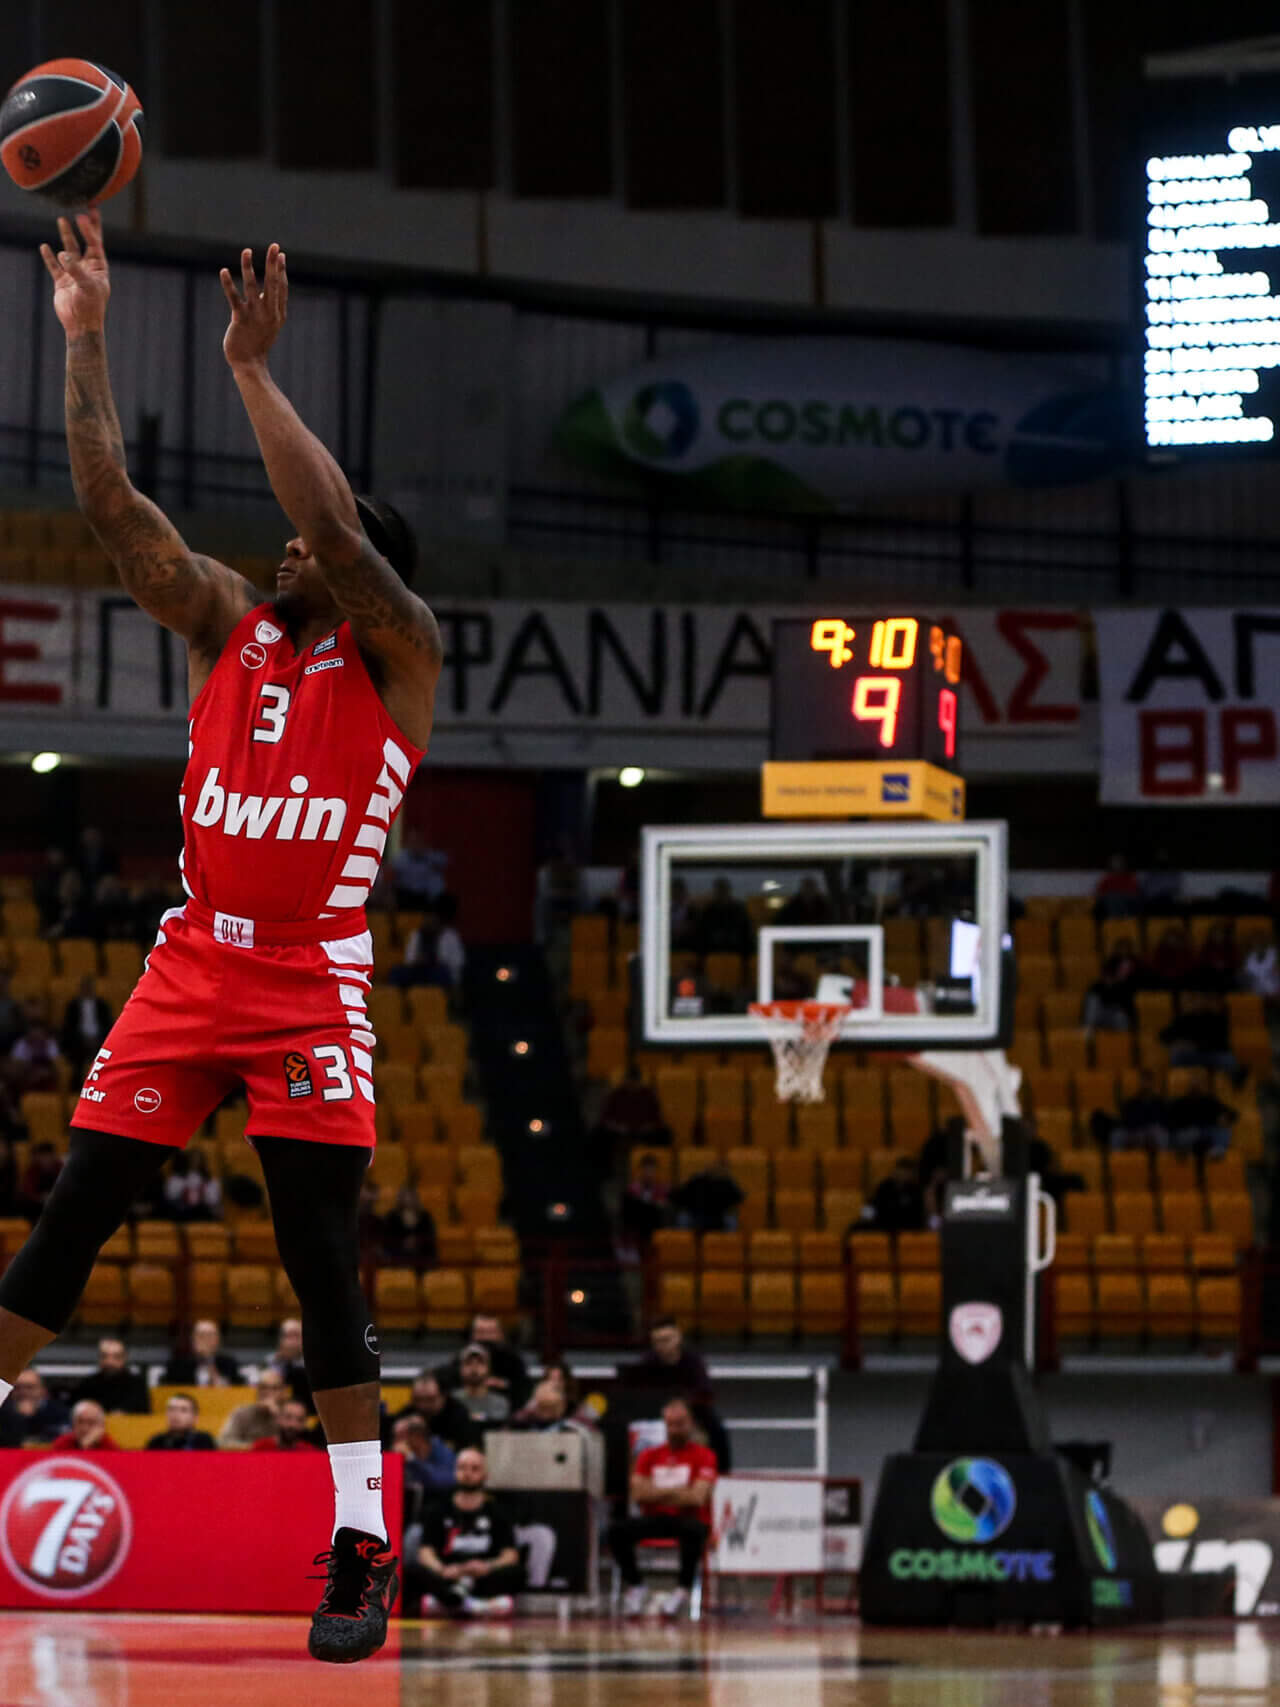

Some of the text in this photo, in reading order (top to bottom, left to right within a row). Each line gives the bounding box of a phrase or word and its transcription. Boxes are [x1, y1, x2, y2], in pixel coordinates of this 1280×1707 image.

[718, 399, 999, 453] COSMOTE
[811, 617, 918, 669] 9:10
[253, 683, 291, 744] 3
[852, 676, 901, 748] 9
[192, 767, 348, 841] bwin
[313, 1045, 353, 1101] 3
[22, 1477, 95, 1578] 7
[889, 1550, 1054, 1581] COSMOTE
